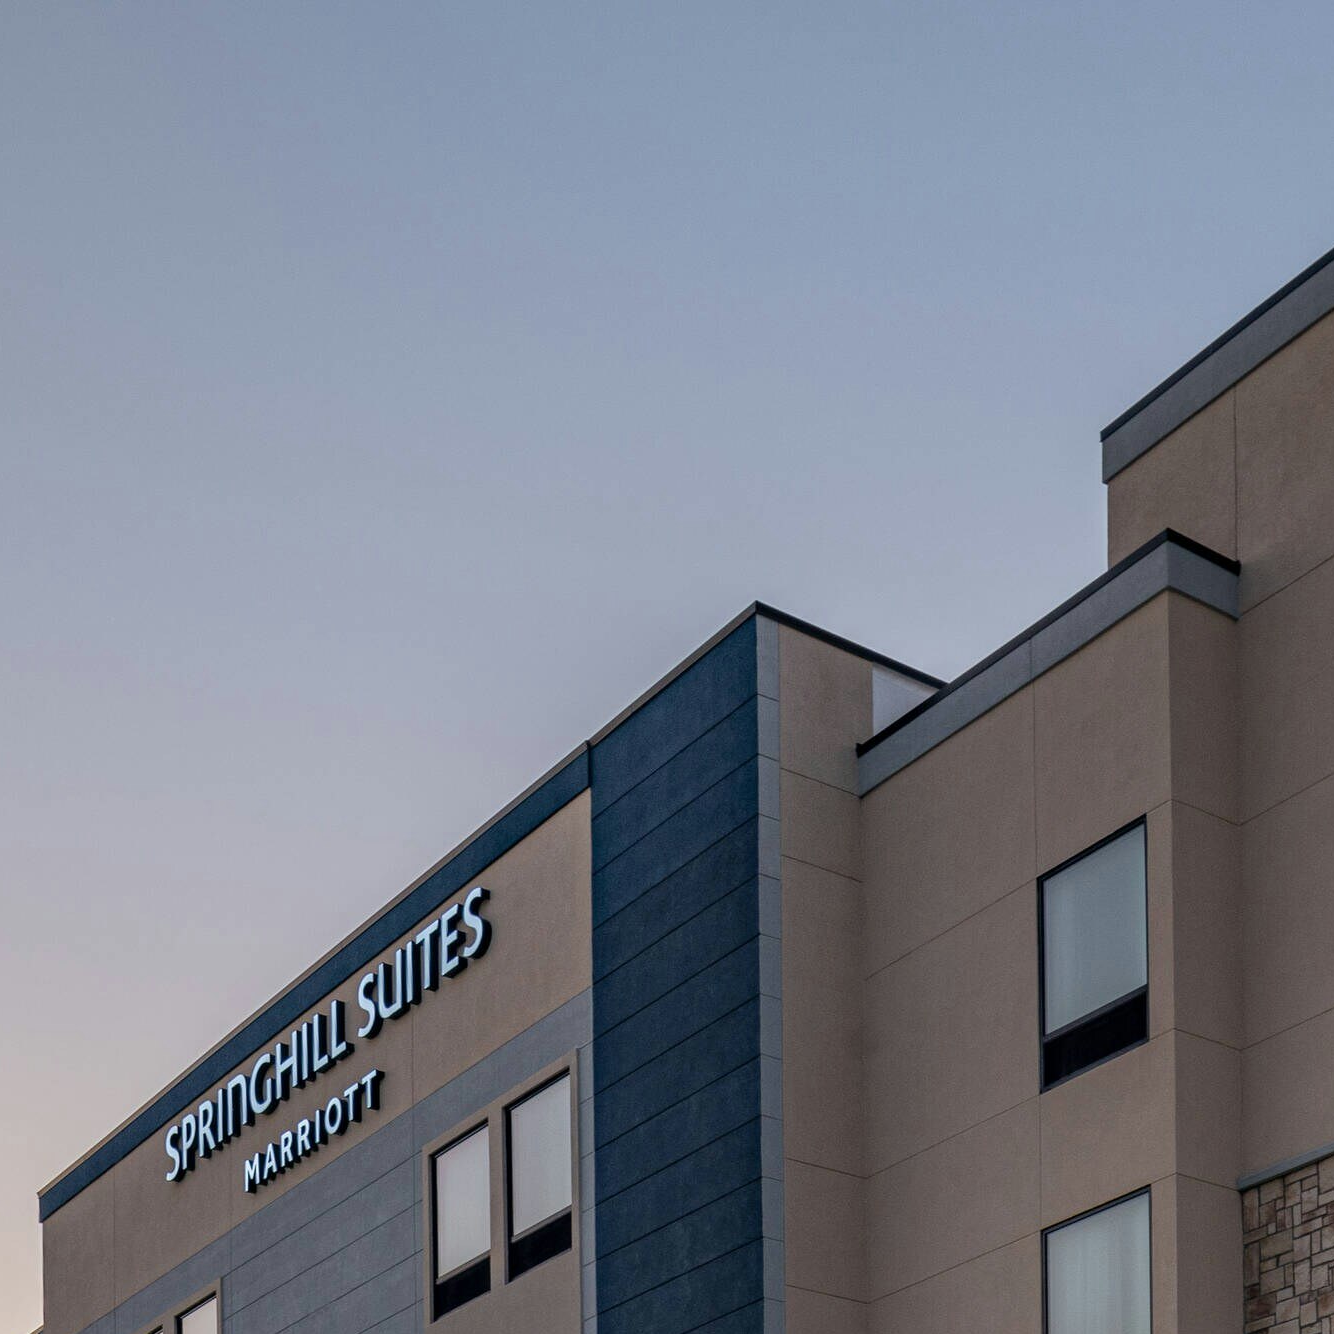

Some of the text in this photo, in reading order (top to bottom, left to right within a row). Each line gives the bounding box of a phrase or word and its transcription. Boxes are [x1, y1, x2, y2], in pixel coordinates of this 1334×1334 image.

[165, 886, 491, 1182] SPRINGHILL SUITES
[244, 1068, 385, 1194] MARRIOTT
